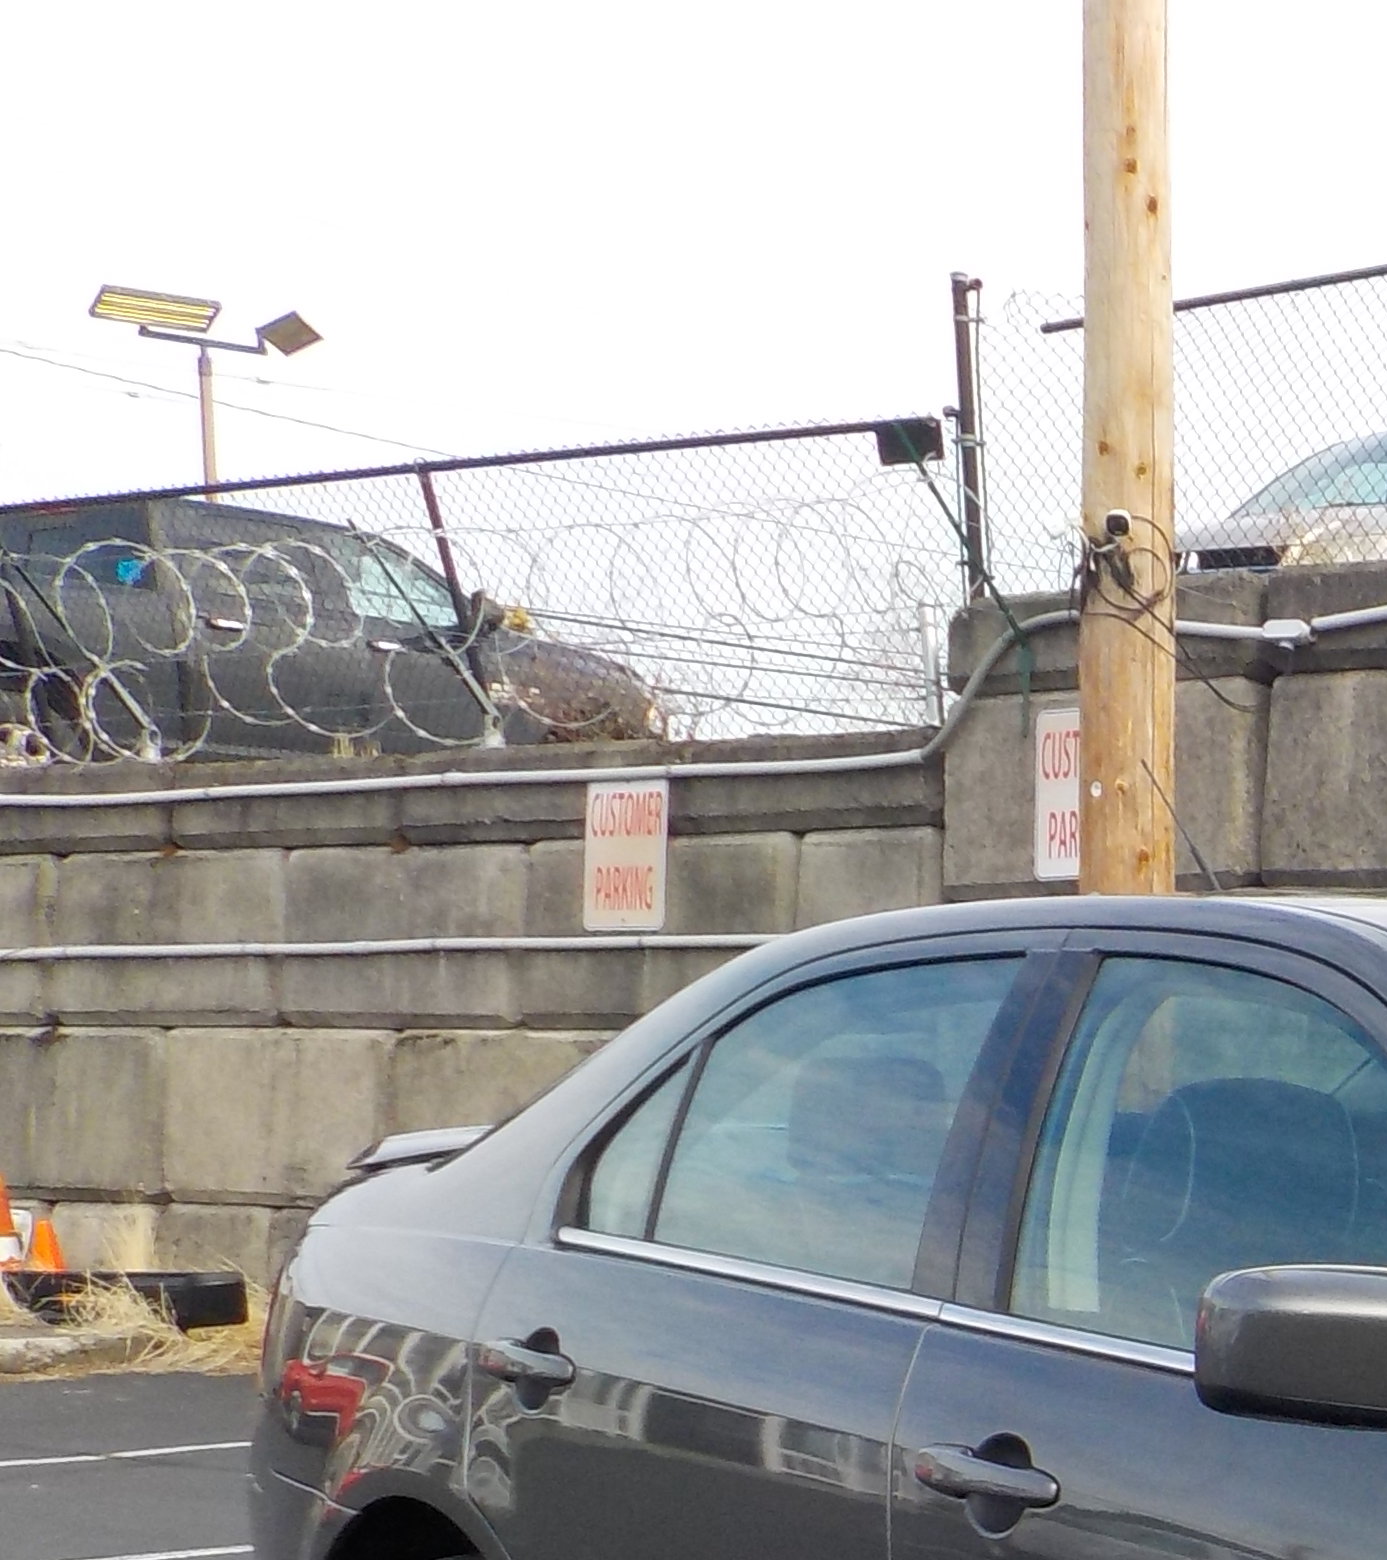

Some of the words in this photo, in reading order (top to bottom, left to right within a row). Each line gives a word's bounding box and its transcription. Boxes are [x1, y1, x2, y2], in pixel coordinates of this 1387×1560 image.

[1041, 730, 1080, 780] CUST
[591, 791, 663, 837] CUSTOMER
[1047, 810, 1080, 859] PAR
[594, 866, 654, 910] PARKING
